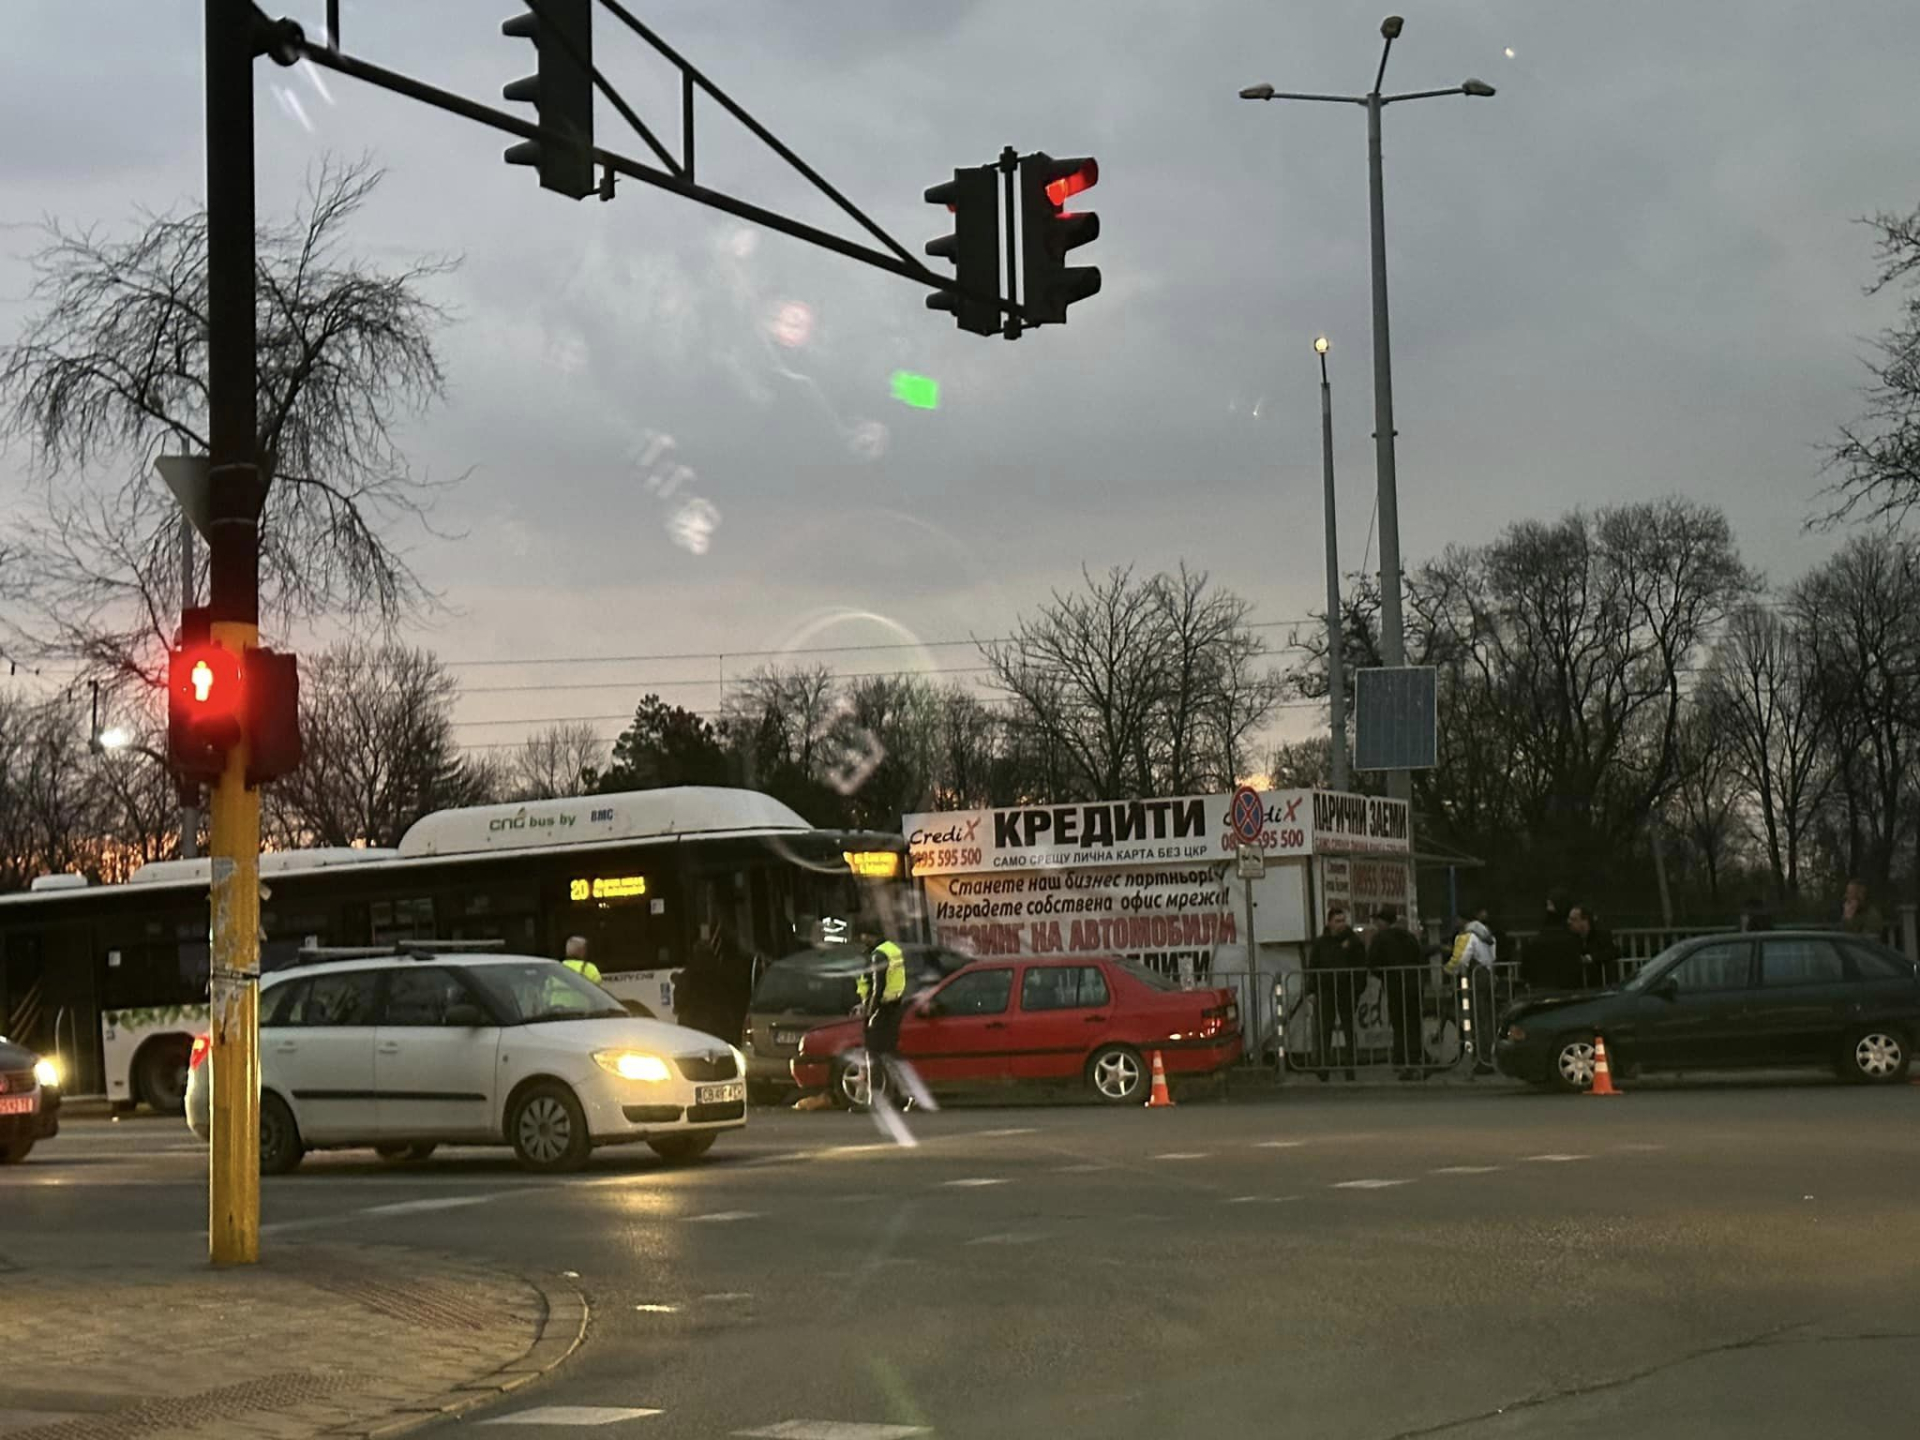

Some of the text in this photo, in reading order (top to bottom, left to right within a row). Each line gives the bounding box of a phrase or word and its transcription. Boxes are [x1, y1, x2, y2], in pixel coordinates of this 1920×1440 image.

[529, 817, 554, 828] bus
[560, 813, 576, 827] by
[591, 809, 613, 822] BMC
[994, 799, 1206, 849] КРЕДИТИ
[1313, 792, 1407, 839] ПАРИЧНИ ЗАЕМИ
[1281, 829, 1304, 848] 500
[937, 848, 958, 867] 595
[961, 847, 982, 866] 500
[993, 855, 1027, 867] САМО
[1073, 850, 1113, 864] ЛИЧНА
[1116, 847, 1154, 861] КАРТА
[1158, 846, 1180, 858] БЕЗ
[1184, 845, 1207, 858] ЦКР
[570, 878, 589, 901] 20
[949, 867, 1213, 896] Станете наш бизнес партньор!
[936, 897, 1022, 921] Изградете
[1027, 894, 1113, 915] собствена
[1121, 888, 1162, 914] офис
[1031, 919, 1064, 954] НА
[1069, 912, 1237, 952] АВТОМОБИЛИ
